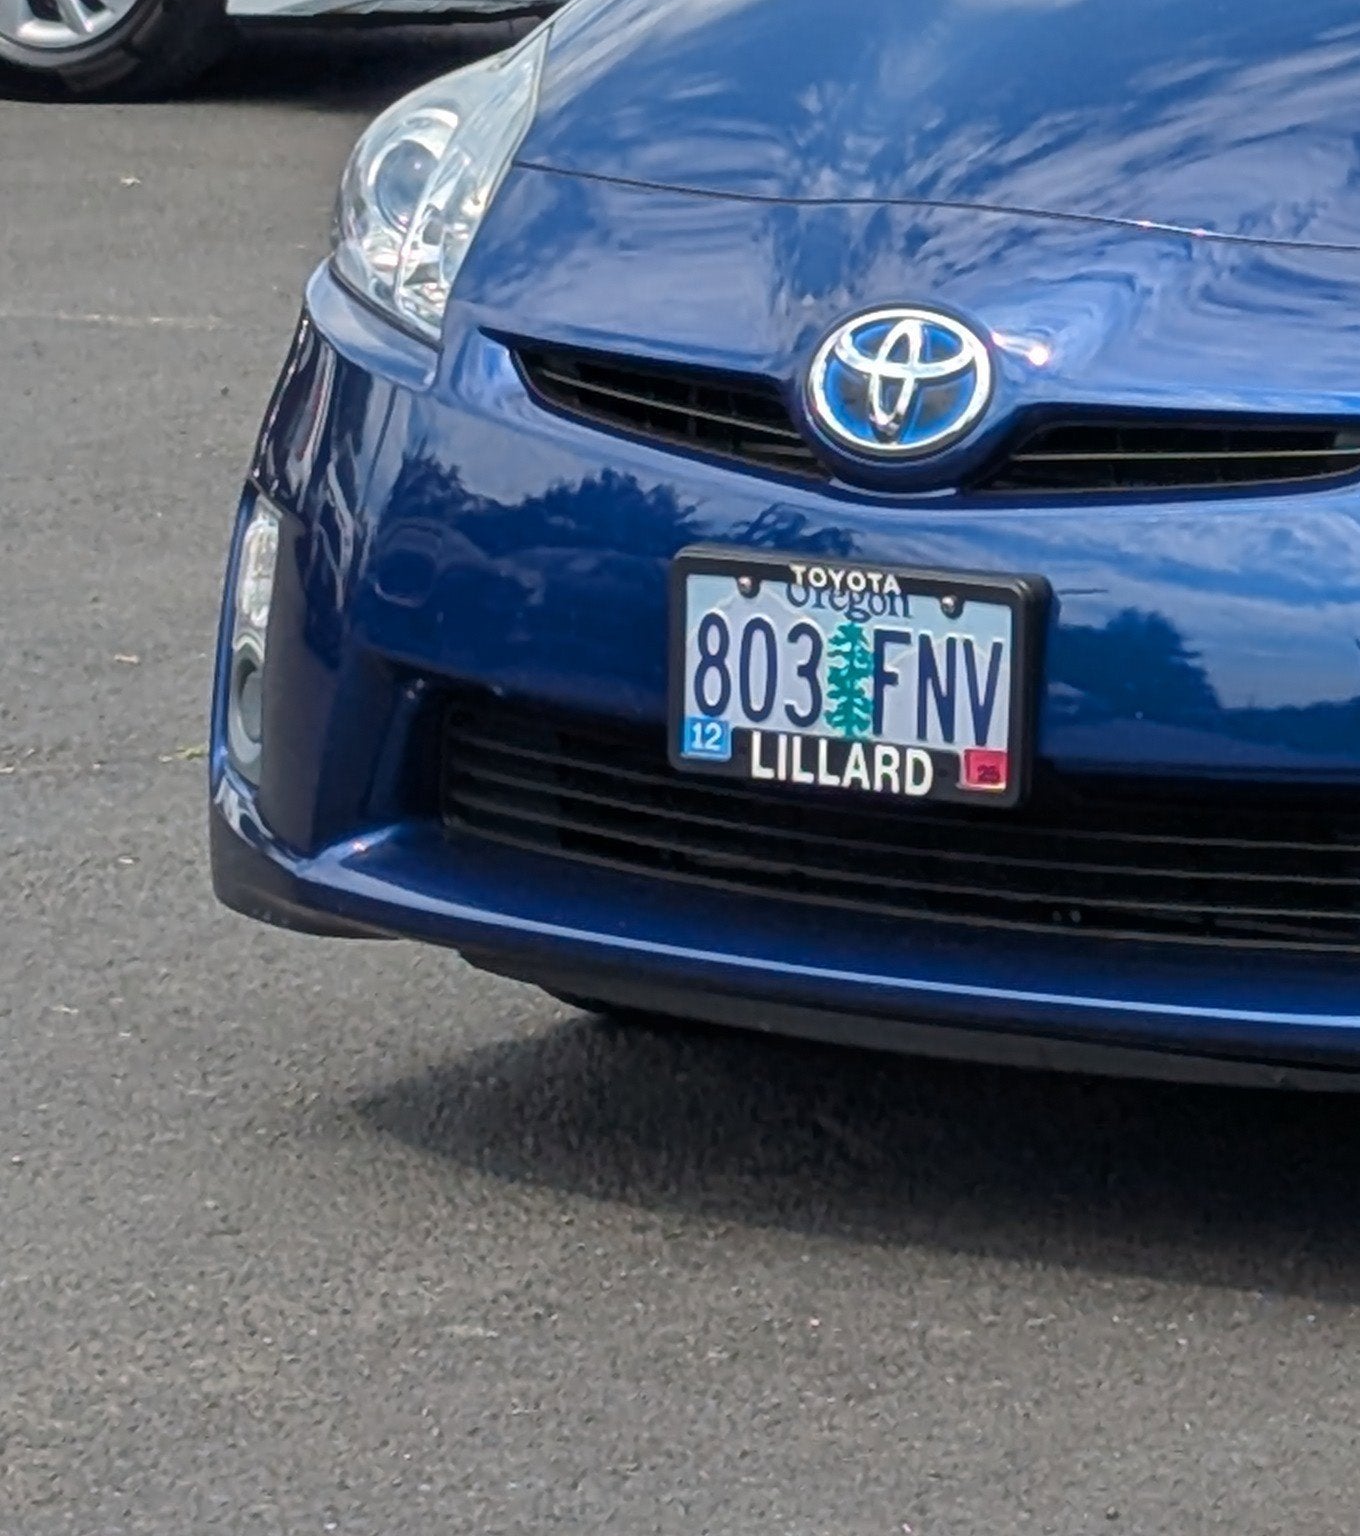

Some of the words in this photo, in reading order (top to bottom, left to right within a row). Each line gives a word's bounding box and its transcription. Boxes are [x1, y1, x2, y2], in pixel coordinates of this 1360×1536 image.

[788, 564, 902, 596] TOYOTA
[693, 611, 824, 728] 803
[871, 628, 1003, 747] FNV
[692, 722, 722, 752] 12
[750, 730, 934, 797] LILLARD
